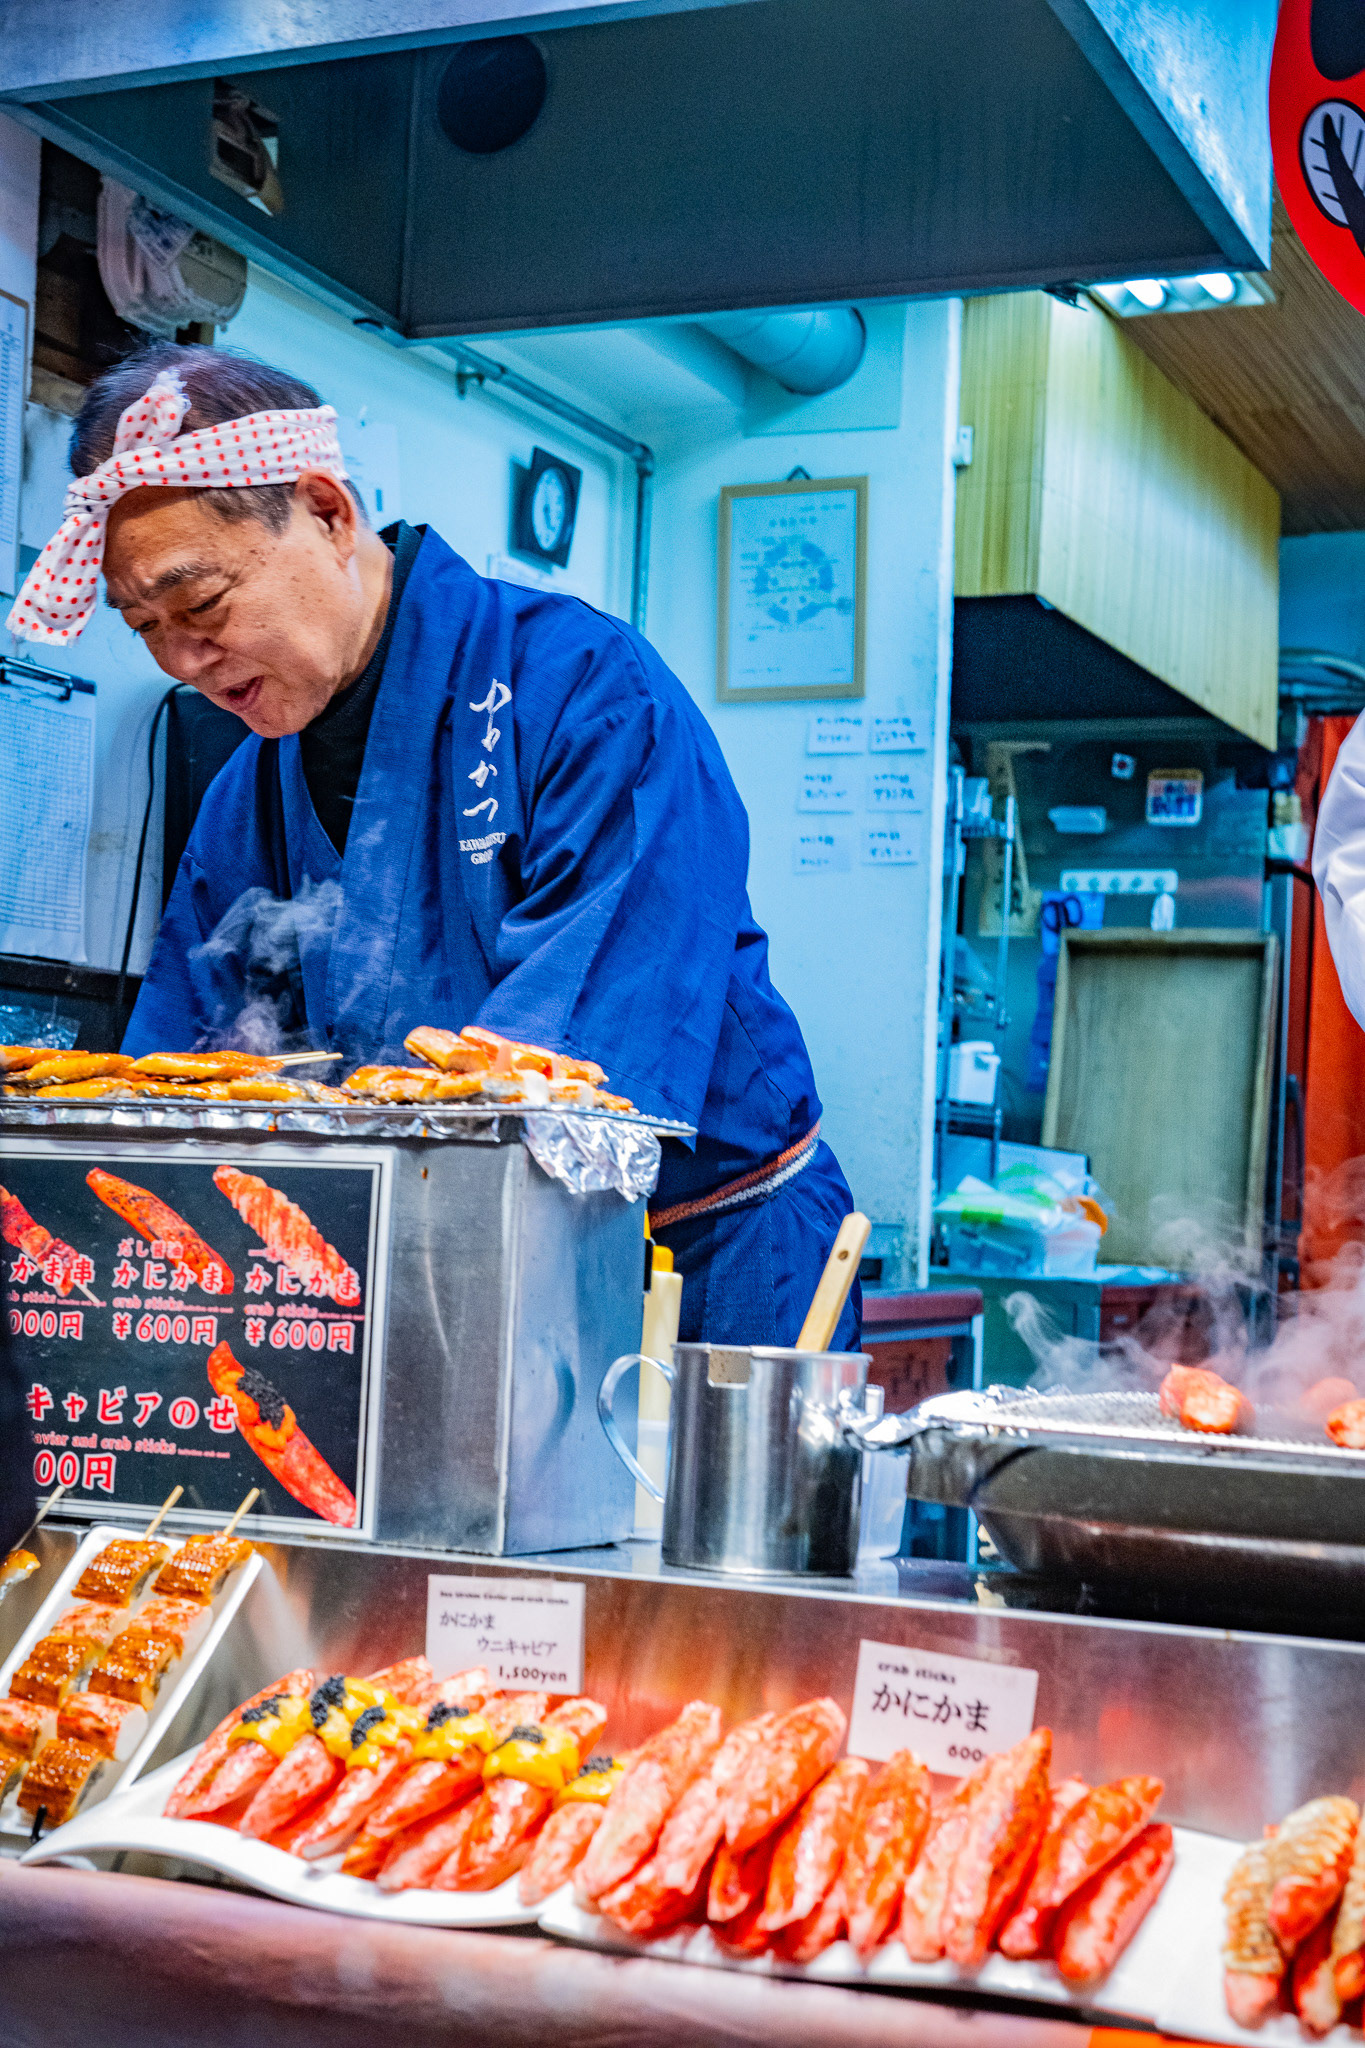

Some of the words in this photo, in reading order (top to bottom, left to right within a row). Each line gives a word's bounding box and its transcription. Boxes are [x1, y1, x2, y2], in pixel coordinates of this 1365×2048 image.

[8, 1253, 96, 1289] かま串
[111, 1259, 224, 1294] かにかま
[243, 1263, 361, 1299] かにかま
[111, 1312, 218, 1348] ¥600円
[244, 1317, 356, 1355] ¥600円
[25, 1383, 239, 1434] キャビアのせ
[31, 1430, 70, 1447] aviar
[71, 1433, 98, 1450] and
[100, 1436, 132, 1452] crab
[134, 1438, 177, 1456] sticks
[33, 1449, 117, 1494] 00円
[476, 1634, 559, 1656] ウニキャビア
[498, 1664, 568, 1685] 1,500yen
[877, 1662, 909, 1676] crab
[915, 1669, 957, 1683] sticks
[872, 1683, 990, 1732] かにかま
[947, 1743, 986, 1763] 600
